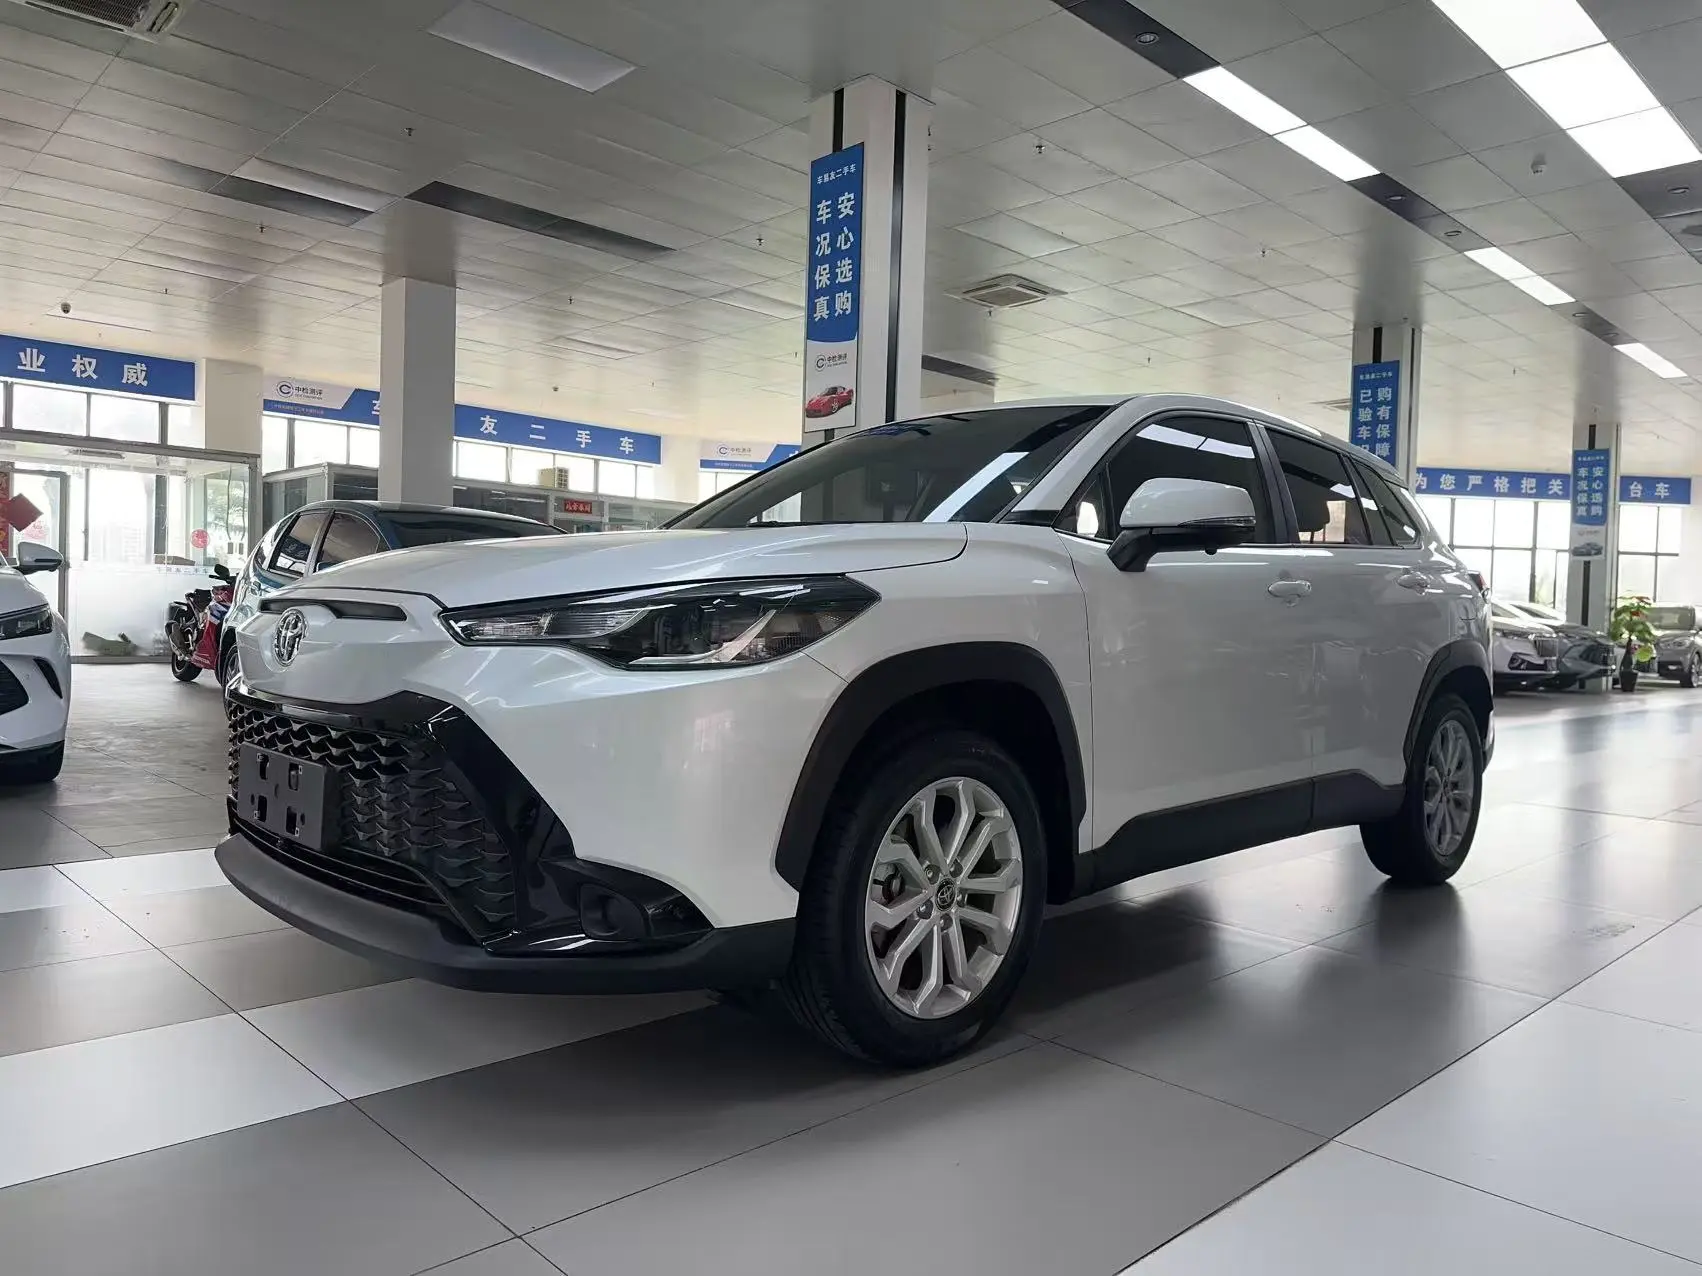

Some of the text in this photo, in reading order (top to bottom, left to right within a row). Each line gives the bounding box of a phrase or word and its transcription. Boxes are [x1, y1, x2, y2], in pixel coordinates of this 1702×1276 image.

[817, 163, 857, 185] 车易友二手车
[813, 199, 832, 322] 车况保真
[834, 191, 855, 317] 安心选购
[16, 347, 149, 387] 业权威
[1375, 386, 1393, 458] 购有保障
[1629, 481, 1671, 499] 台车
